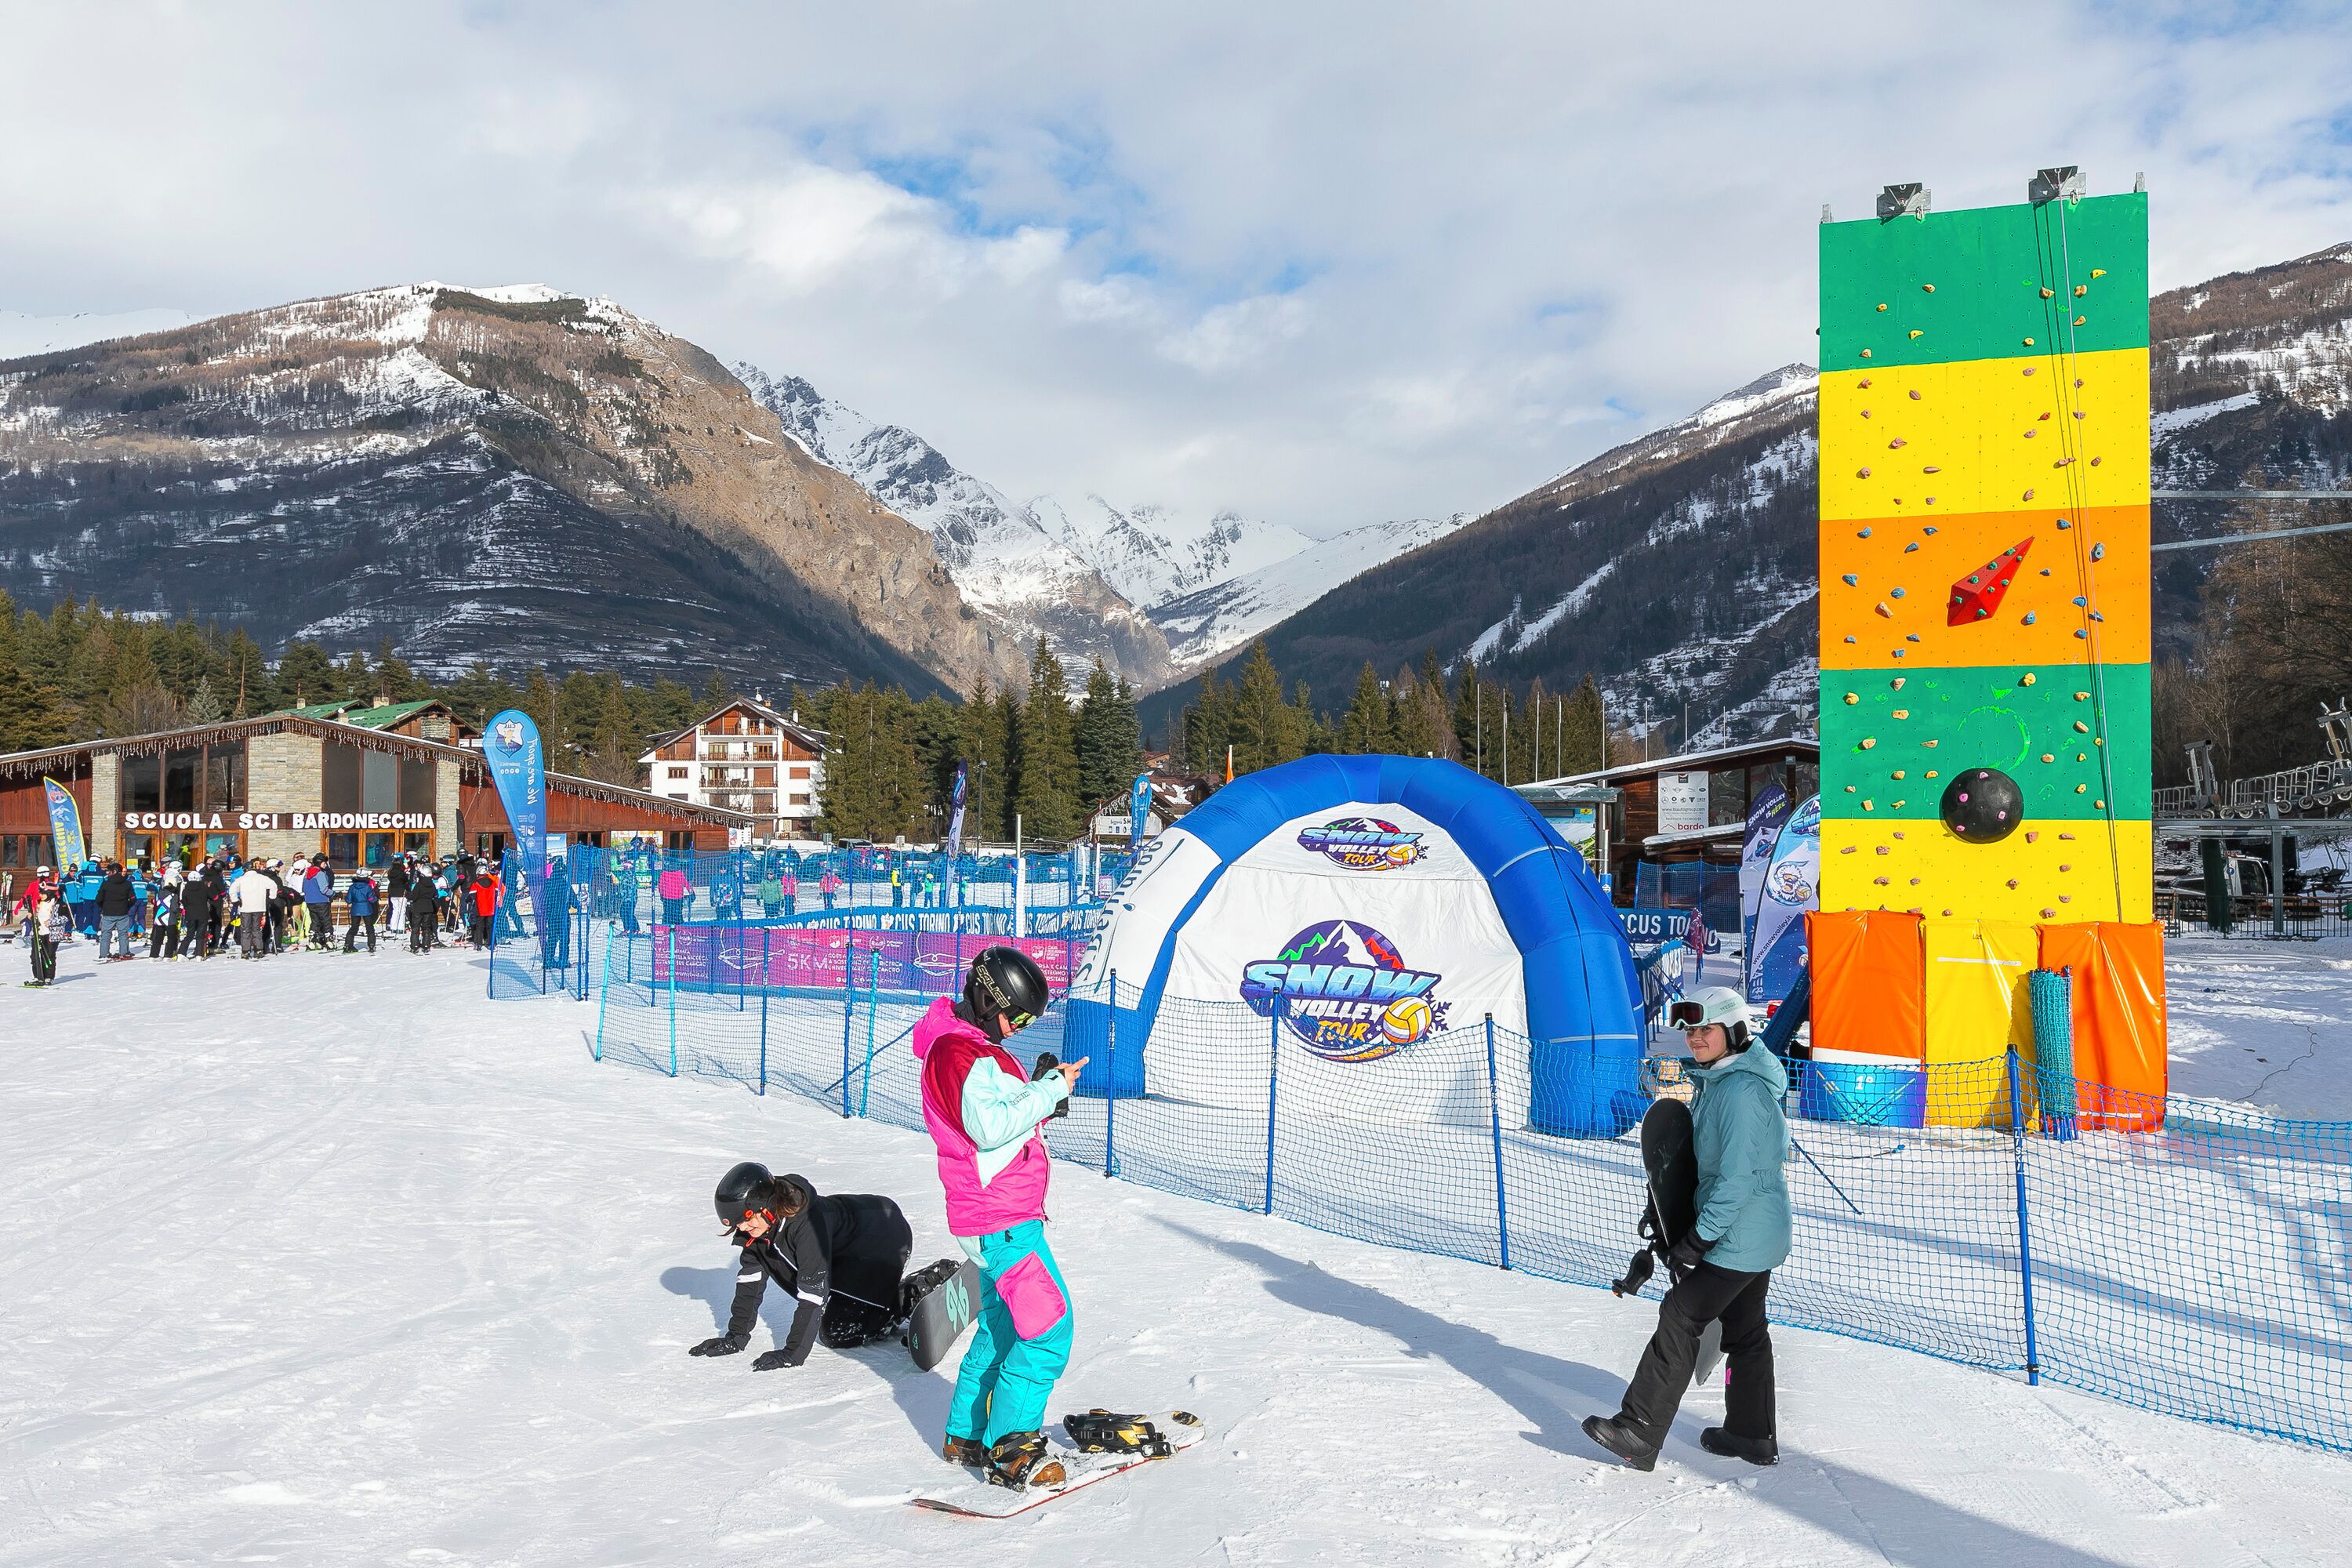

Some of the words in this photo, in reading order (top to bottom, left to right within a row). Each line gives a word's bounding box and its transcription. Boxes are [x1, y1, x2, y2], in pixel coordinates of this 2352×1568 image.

[124, 812, 223, 829] SCUOLA
[238, 812, 278, 829] SCI
[292, 812, 435, 829] BARDONECCHIA
[1748, 806, 1766, 827] SNOW
[1765, 793, 1786, 809] VOLLEY
[1298, 827, 1424, 845] SNOW
[1327, 844, 1391, 854] VOLLEY
[1342, 853, 1377, 864] TOUR
[895, 913, 916, 931] CUS
[918, 913, 950, 932] TORINO
[965, 912, 981, 934] CUS
[982, 912, 1007, 935] TORINO
[1627, 913, 1661, 935] CUS
[1752, 914, 1793, 965] www.snowvolley.it
[975, 964, 1011, 1008] SALICE
[1241, 963, 1439, 1001] SNOW
[1290, 999, 1390, 1020] VOLLEY
[1313, 1019, 1370, 1043] TOUR
